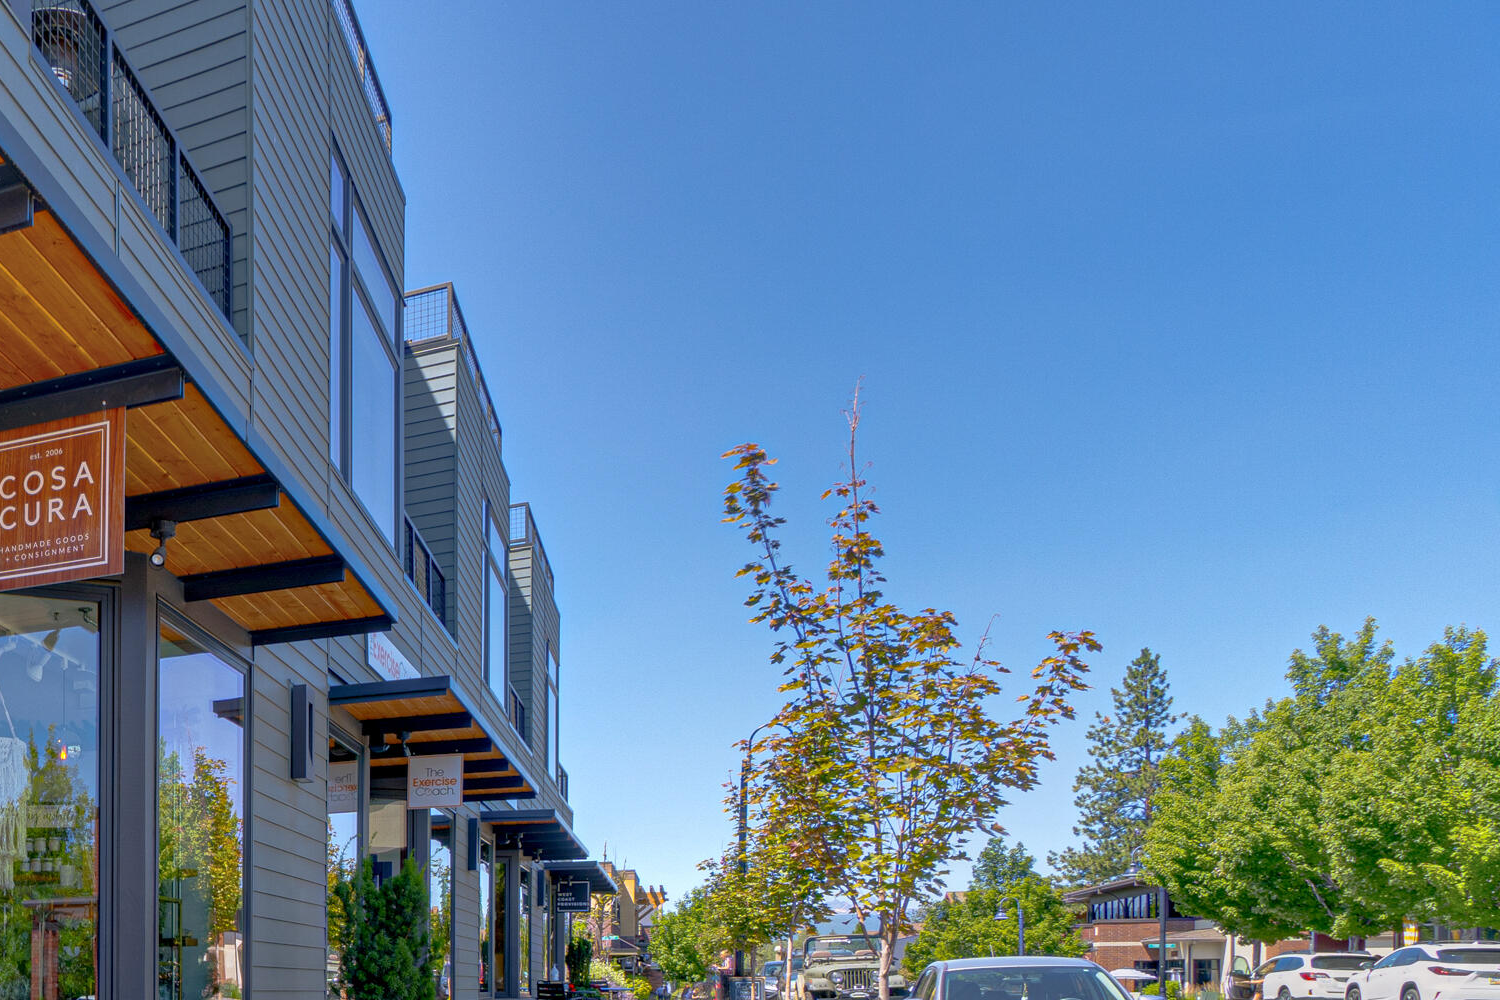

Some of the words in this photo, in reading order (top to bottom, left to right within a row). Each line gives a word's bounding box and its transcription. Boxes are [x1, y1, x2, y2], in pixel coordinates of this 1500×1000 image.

[30, 452, 42, 460] est.
[45, 448, 63, 458] 2006
[0, 493, 93, 530] CURA
[55, 533, 89, 545] GOODS
[14, 544, 85, 562] CONSIGNMENT
[425, 767, 445, 777] The
[412, 777, 457, 787] Exercise
